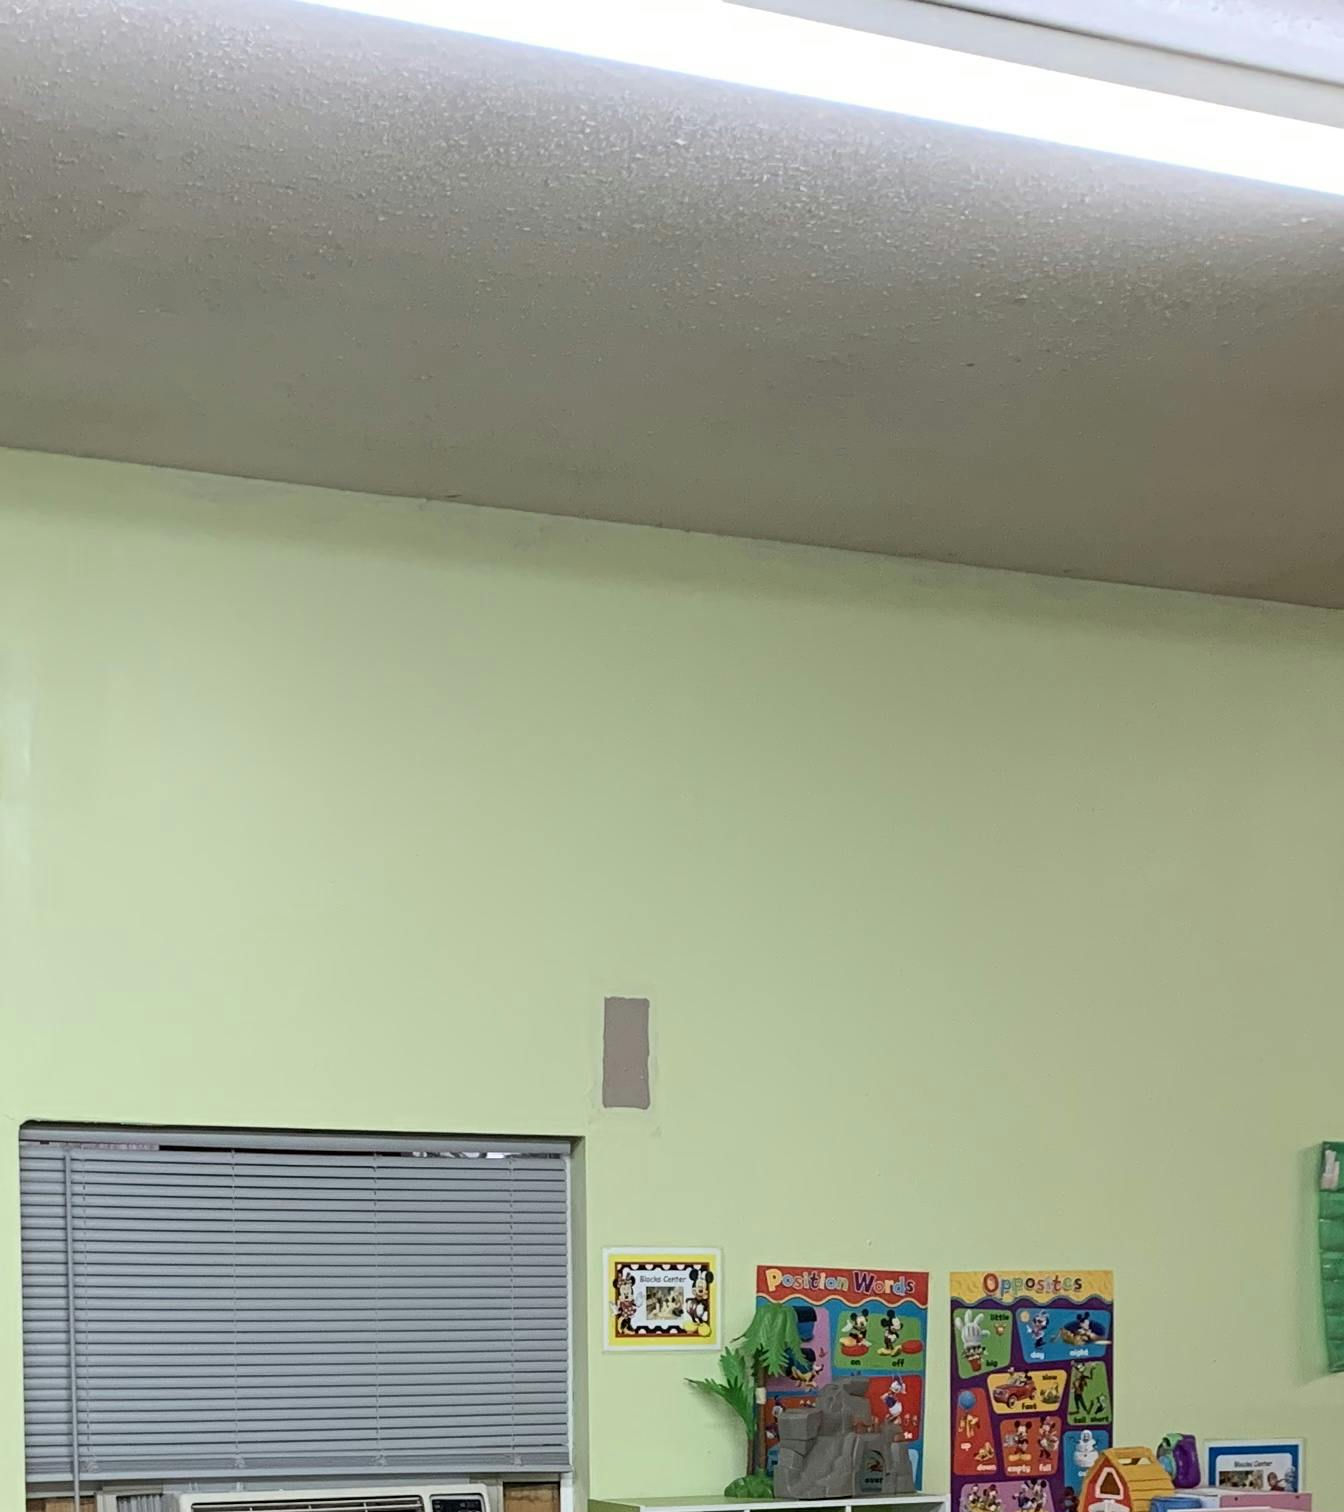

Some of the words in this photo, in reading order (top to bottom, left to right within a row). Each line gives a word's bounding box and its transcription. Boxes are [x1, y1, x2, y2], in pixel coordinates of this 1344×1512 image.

[765, 1268, 849, 1292] Position
[853, 1271, 916, 1296] Words
[983, 1272, 1083, 1297] Opposites
[990, 1313, 1010, 1321] little
[1030, 1351, 1045, 1360] day
[1069, 1349, 1089, 1358] night
[891, 1358, 904, 1367] off
[1022, 1402, 1037, 1410] fast
[960, 1442, 972, 1452] up
[976, 1463, 997, 1472] down
[1007, 1463, 1032, 1475] empty
[1039, 1463, 1052, 1472] full
